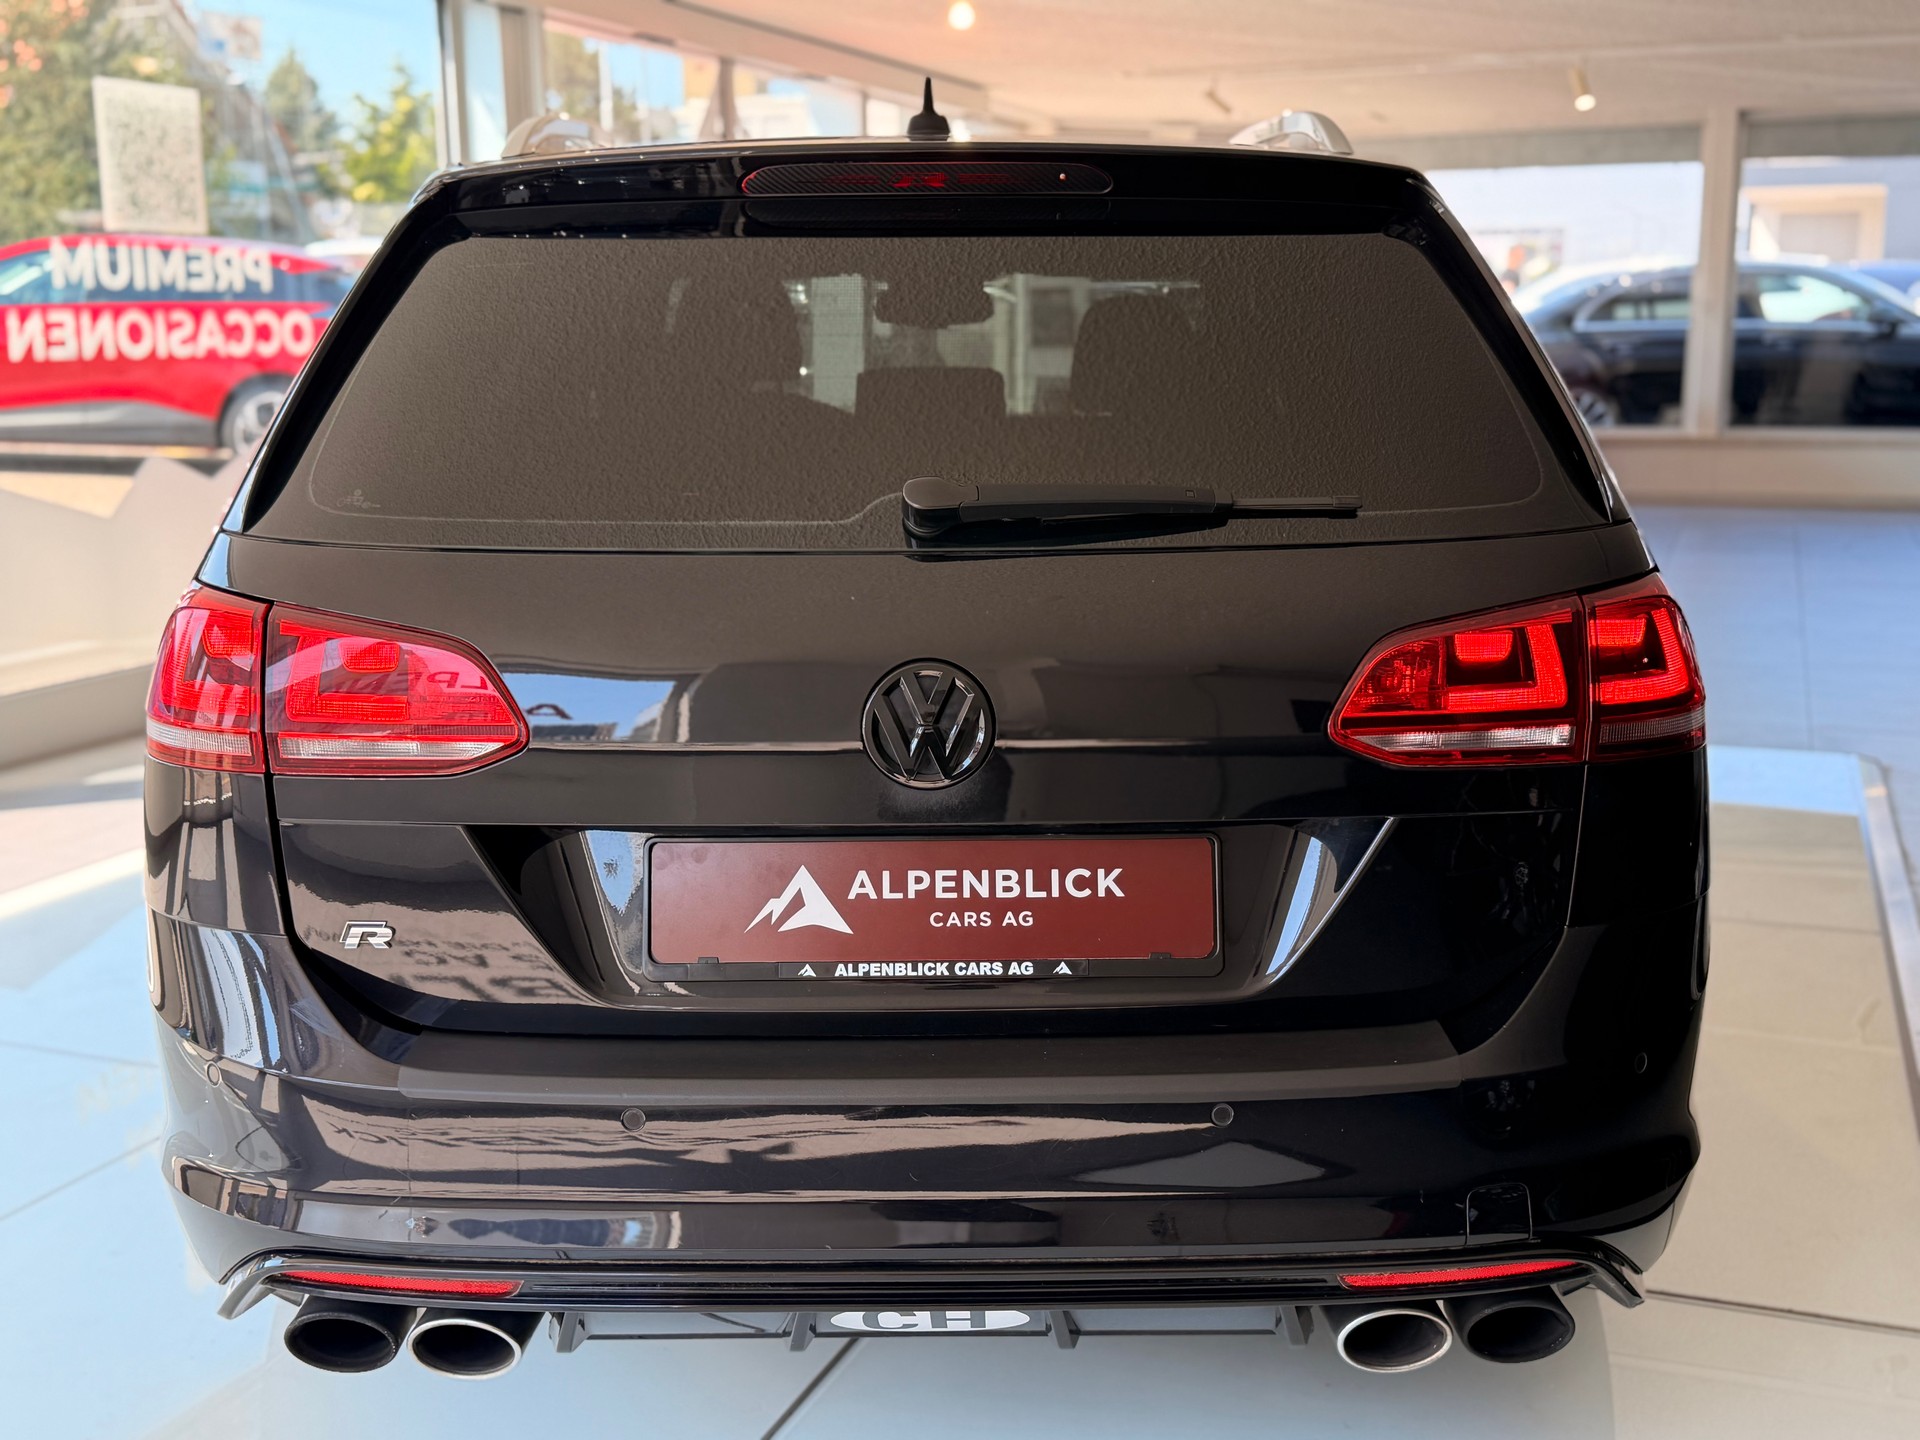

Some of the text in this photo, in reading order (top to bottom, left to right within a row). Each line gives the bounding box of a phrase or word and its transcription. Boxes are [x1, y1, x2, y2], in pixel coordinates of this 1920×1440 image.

[847, 868, 1126, 900] ALPENBLICK
[929, 911, 1034, 927] CARS AG
[340, 921, 394, 949] R
[834, 961, 1034, 977] ALPENBLICK CARS AG
